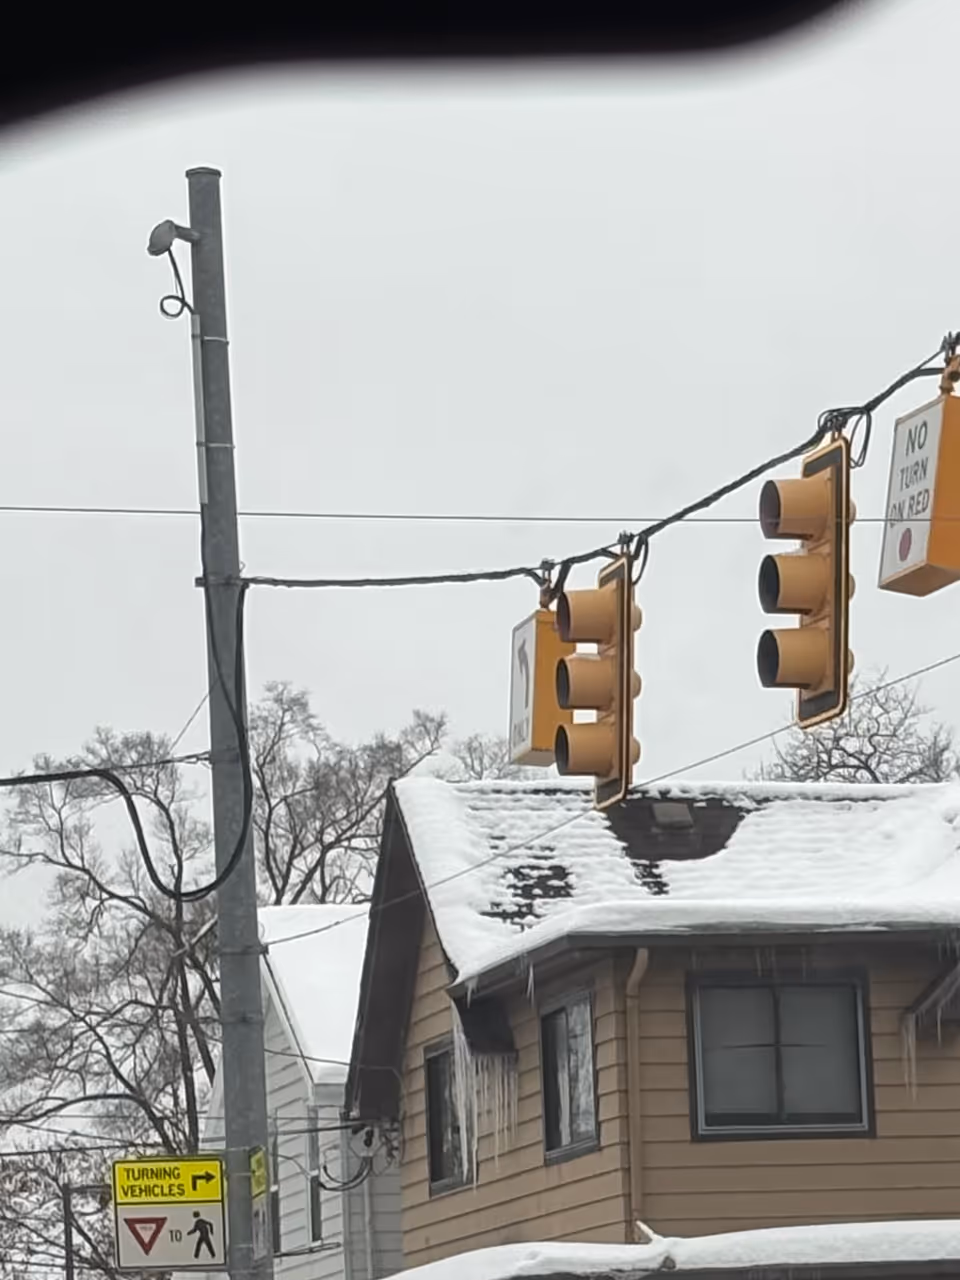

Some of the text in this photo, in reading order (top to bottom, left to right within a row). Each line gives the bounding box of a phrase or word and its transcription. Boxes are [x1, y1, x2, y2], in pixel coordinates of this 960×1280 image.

[905, 420, 929, 457] NO
[899, 457, 930, 492] TURN
[889, 488, 930, 529] ON RED
[121, 1184, 186, 1198] VEHICLES
[123, 1166, 182, 1182] TURNING
